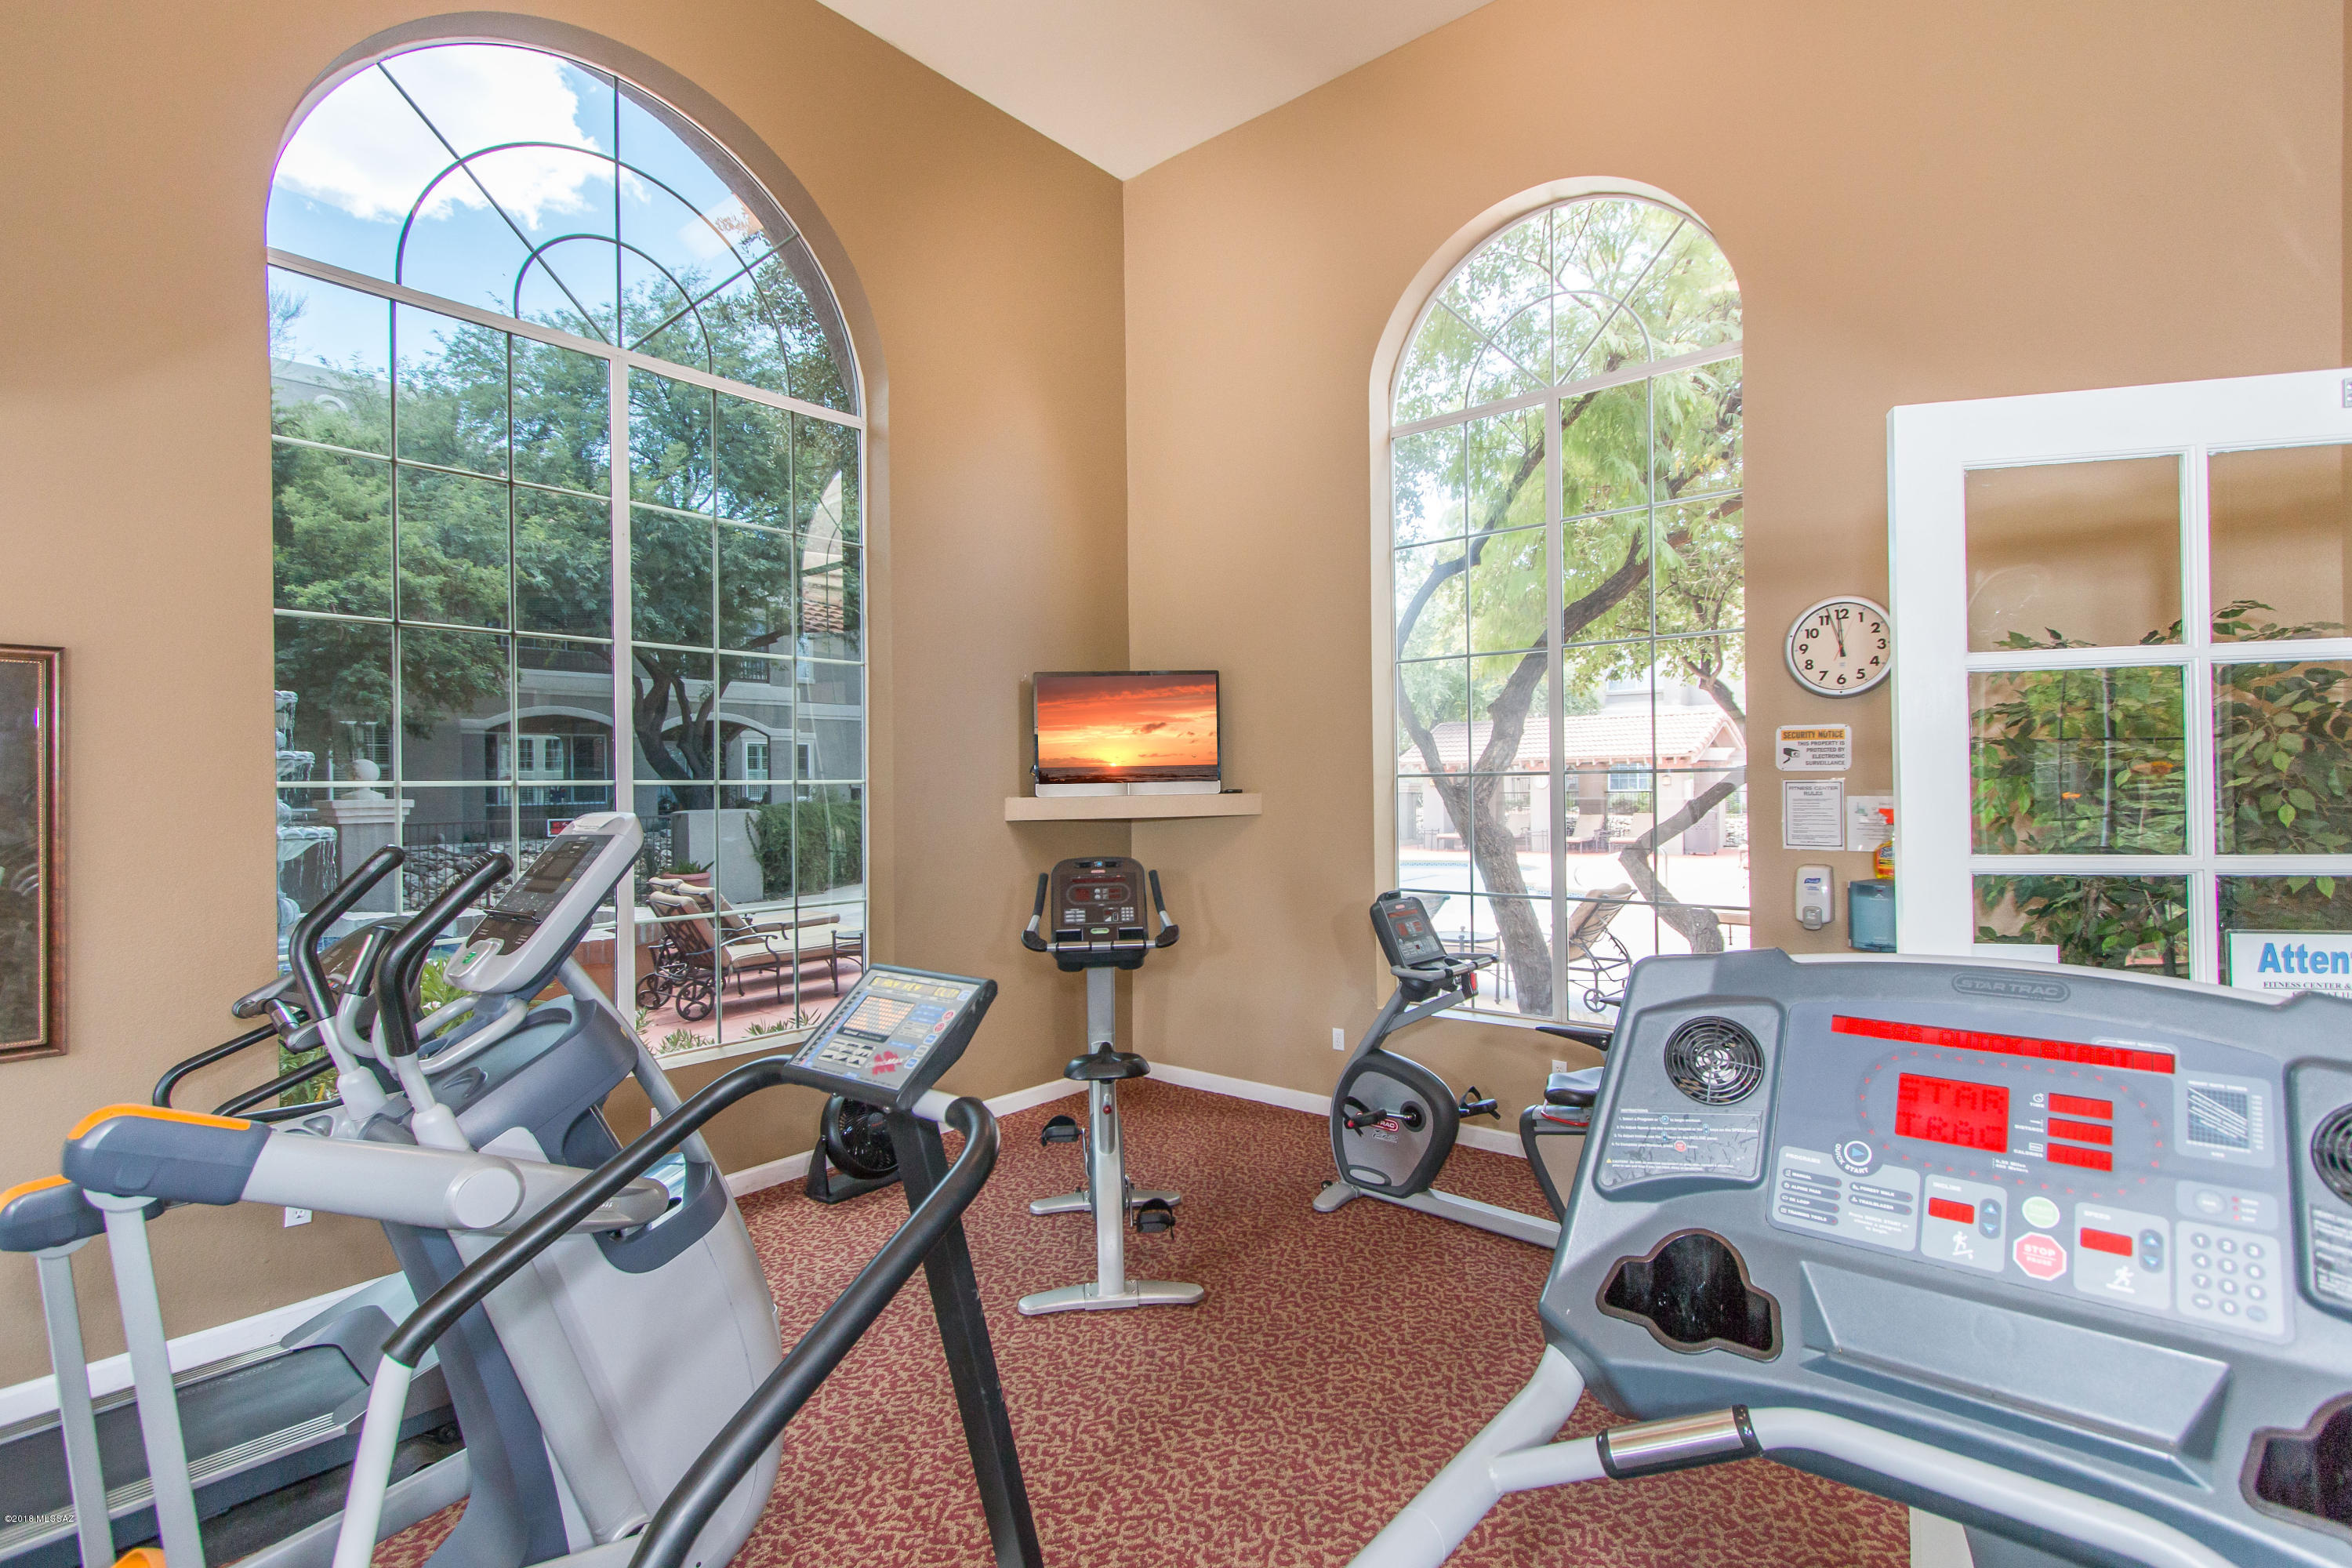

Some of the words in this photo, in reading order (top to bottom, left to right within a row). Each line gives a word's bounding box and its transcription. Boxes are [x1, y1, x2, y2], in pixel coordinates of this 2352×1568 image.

[1835, 608, 1849, 620] 12
[1859, 612, 1864, 622] 1
[1819, 615, 1830, 626] 11
[1871, 622, 1880, 633] 2
[1805, 628, 1819, 639] 10
[1799, 644, 1808, 654] 9
[1877, 638, 1886, 649] 3
[1805, 659, 1813, 670] 8
[1870, 655, 1879, 666] 4
[1819, 670, 1828, 681] 7
[1857, 668, 1866, 679] 5
[1837, 674, 1846, 685] 6
[1783, 731, 1816, 739] SECURITY
[2258, 942, 2352, 974] Atten
[1960, 979, 2006, 991] STAR
[2009, 984, 2060, 996] TRAC
[1938, 1029, 2023, 1055] QUICK
[2040, 1040, 2133, 1069] START
[1899, 1076, 2004, 1114] STAR
[1897, 1111, 2004, 1149] TRAC
[1835, 1143, 1846, 1165] QUICK
[1844, 1163, 1869, 1174] START
[2024, 1243, 2056, 1257] STOP
[2196, 1236, 2204, 1247] 1
[2223, 1240, 2232, 1251] 2
[2249, 1245, 2259, 1257] 3
[2026, 1255, 2053, 1267] PAUSE
[2196, 1256, 2206, 1267] 4
[2197, 1275, 2206, 1287] 7
